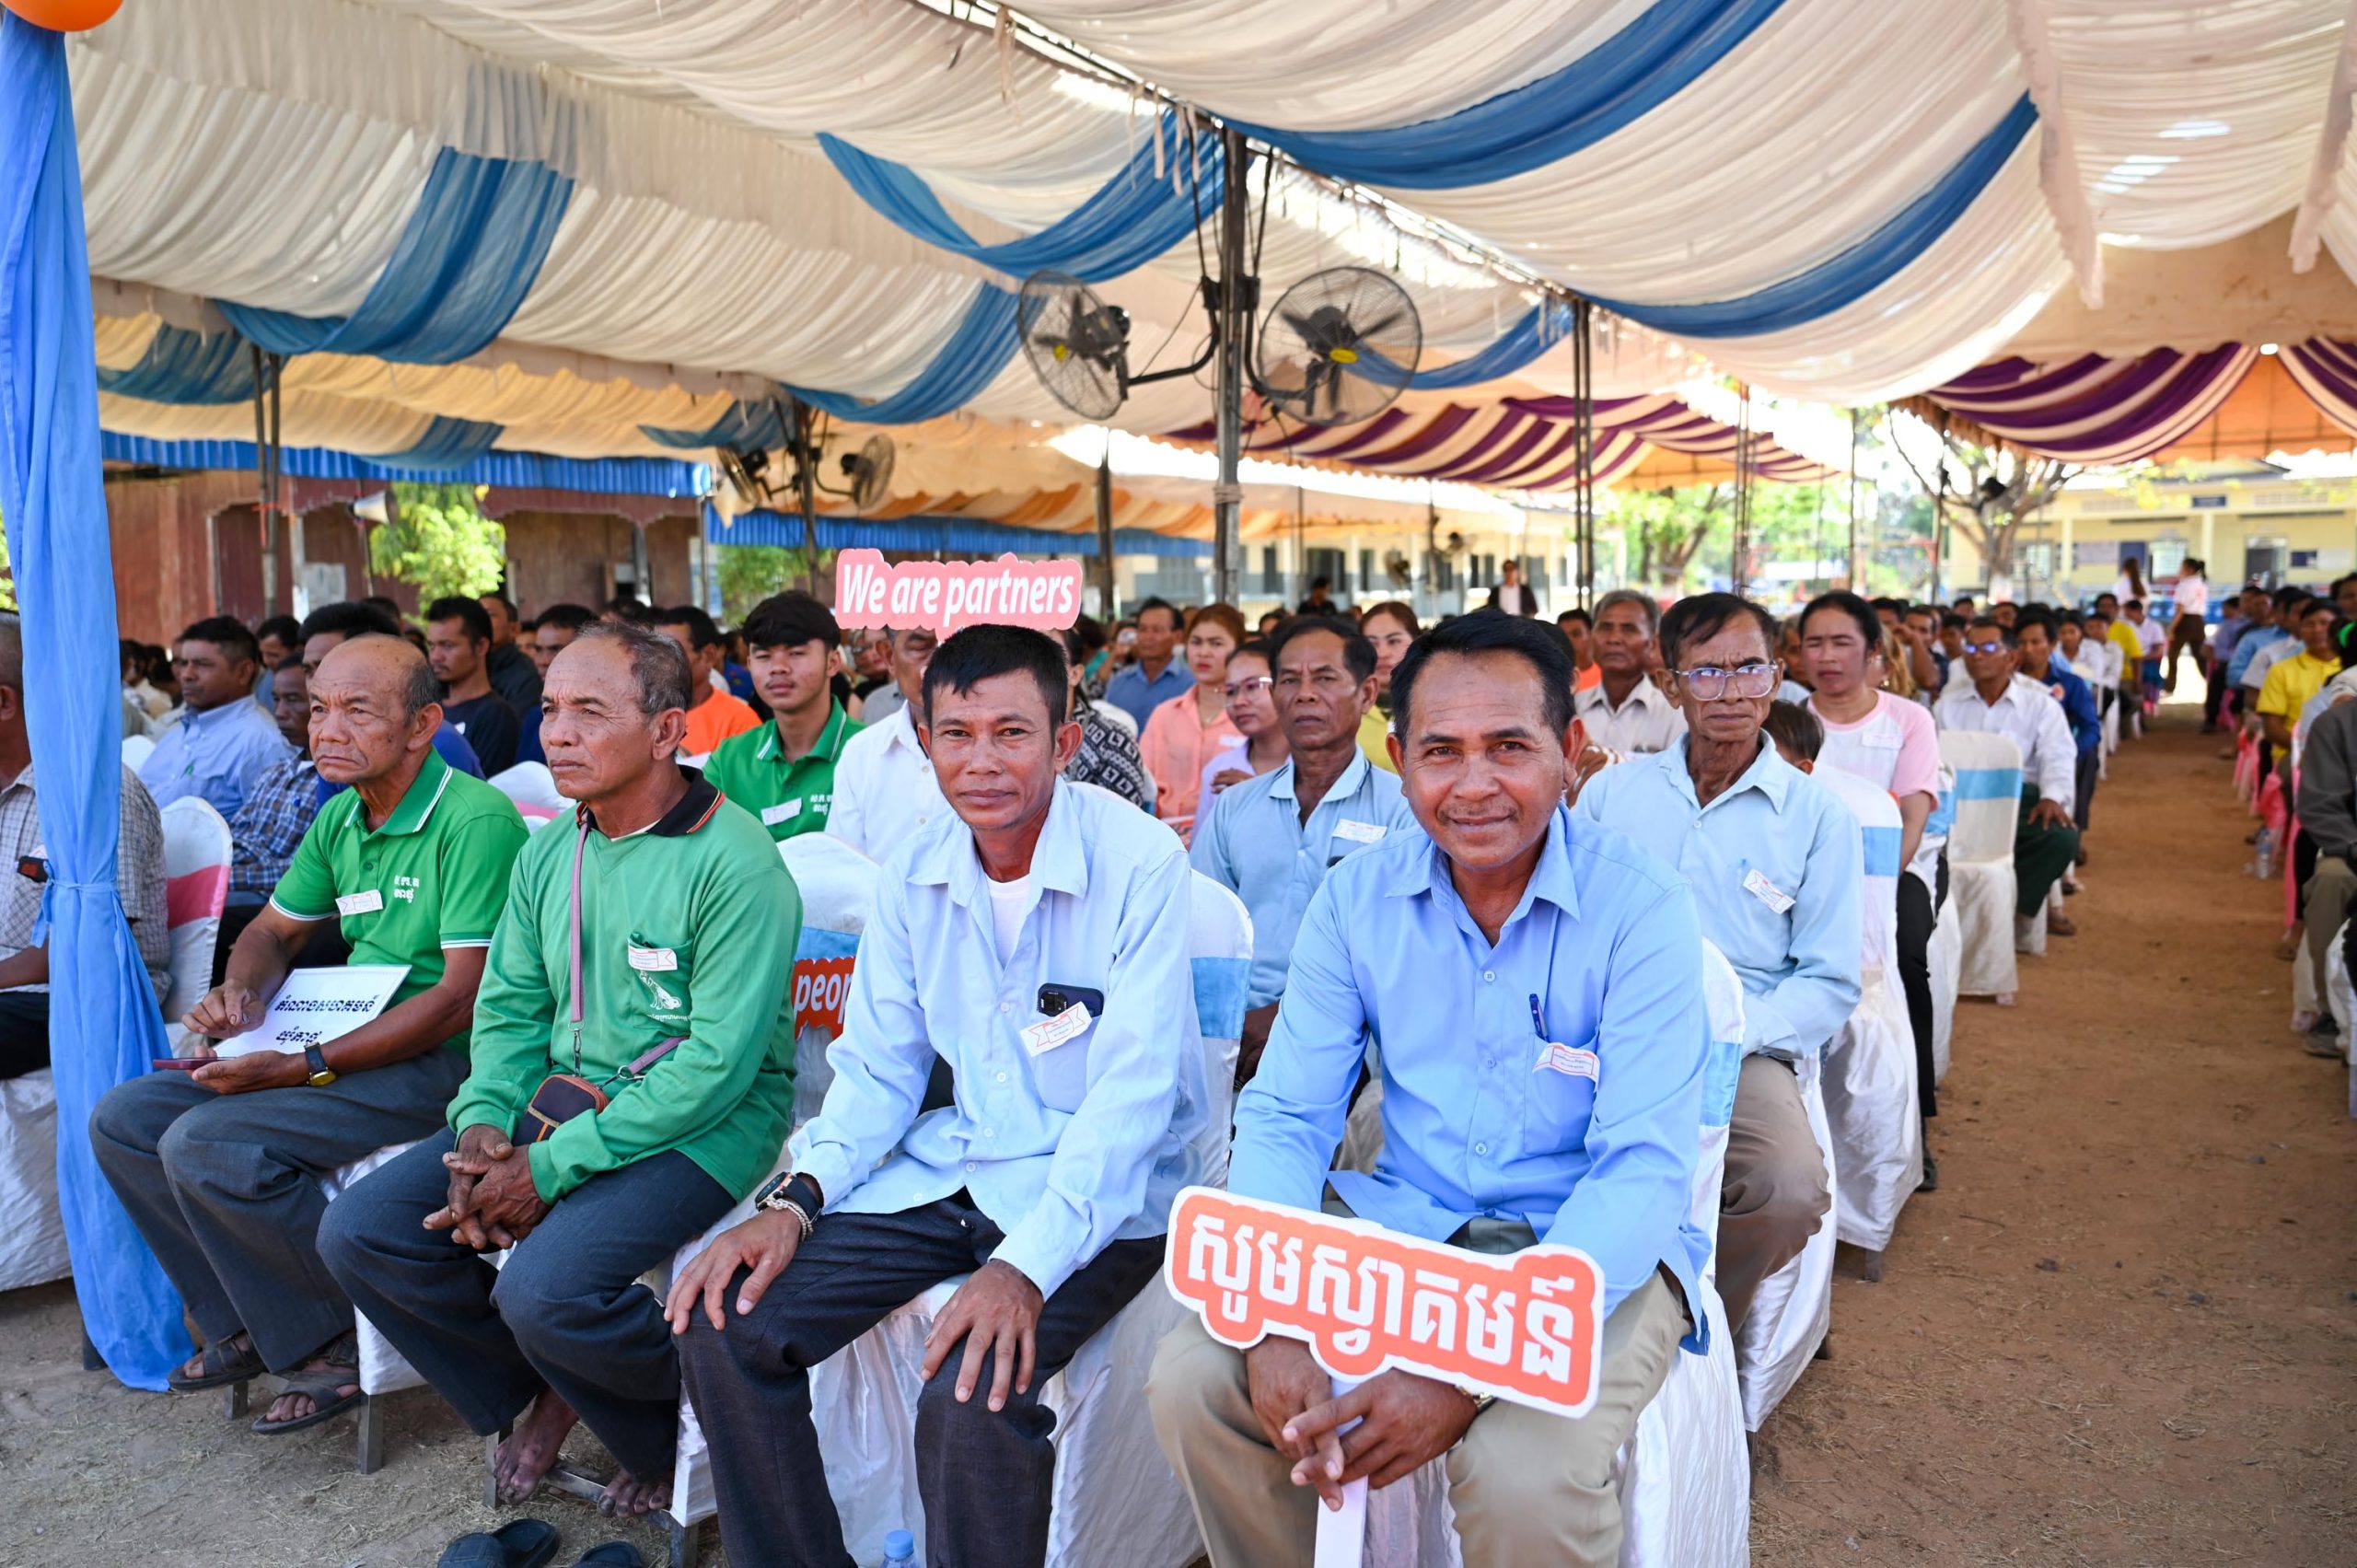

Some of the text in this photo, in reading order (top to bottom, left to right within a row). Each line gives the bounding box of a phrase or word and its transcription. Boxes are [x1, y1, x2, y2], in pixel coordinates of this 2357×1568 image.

[842, 563, 1074, 628] We are partners
[1188, 1213, 1576, 1385] សូមស្វាគមន៍
